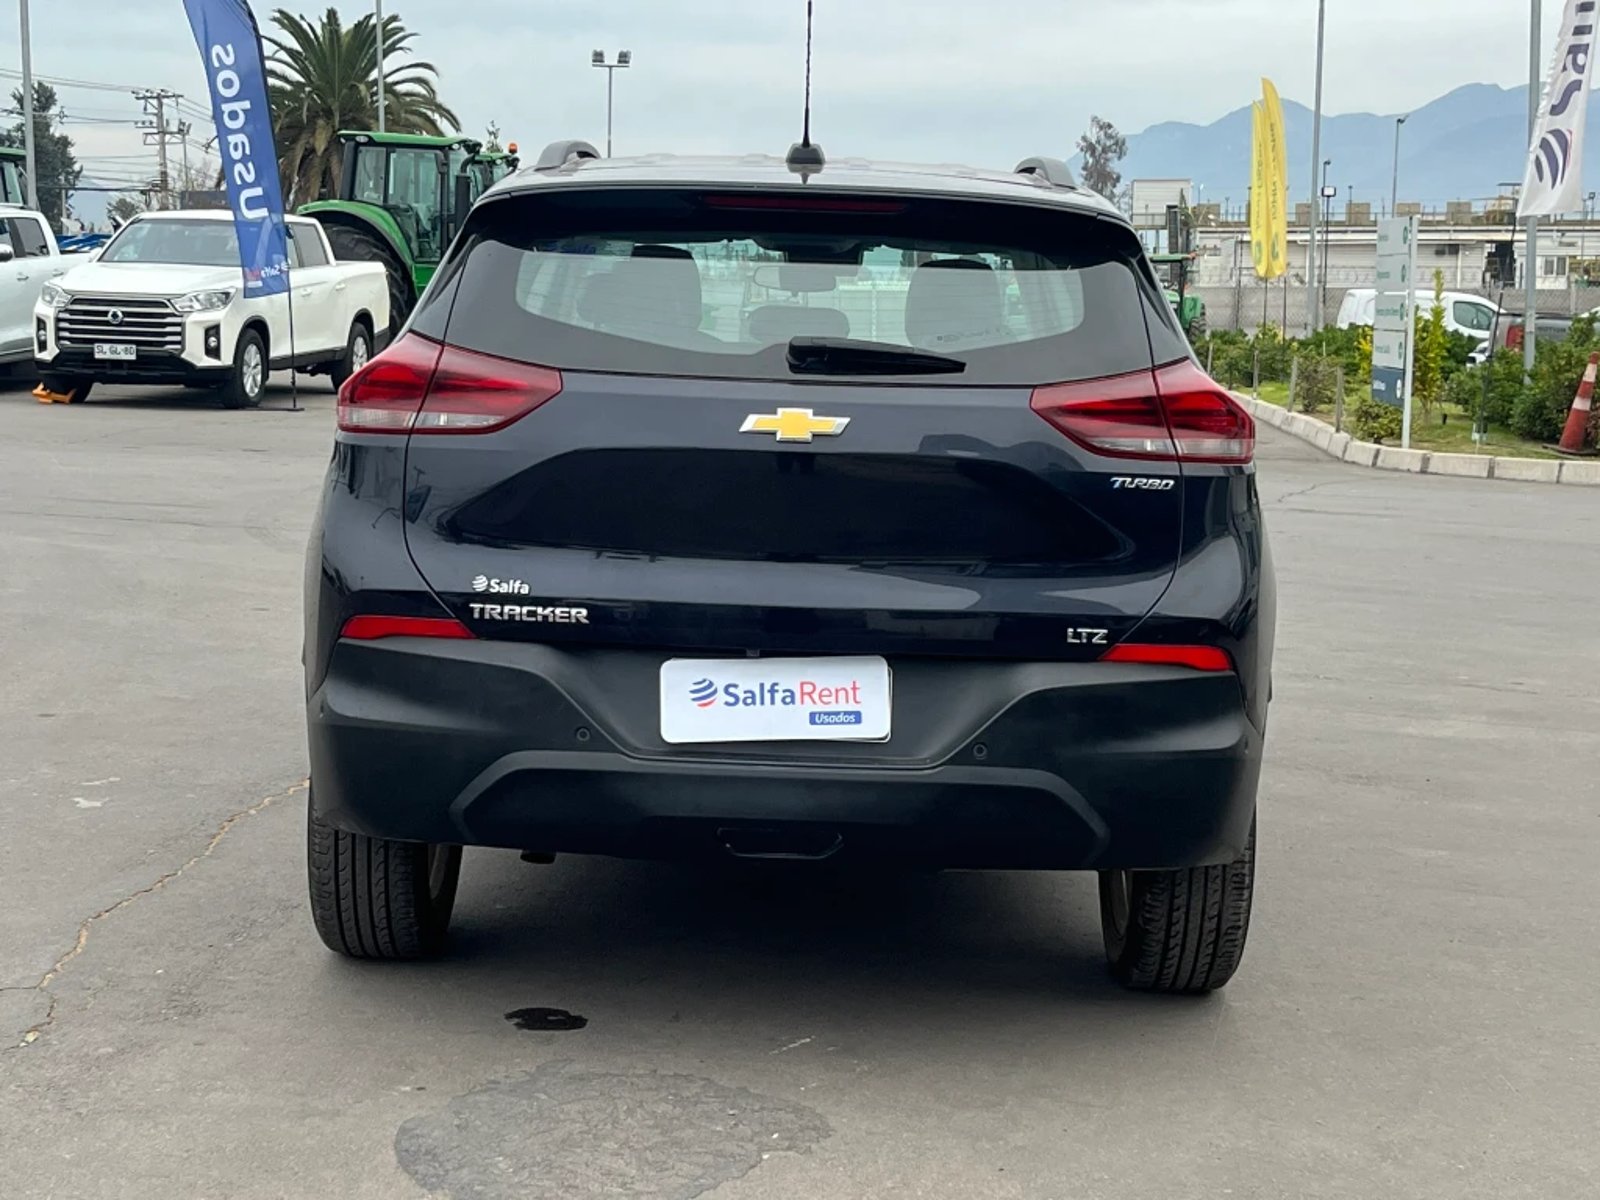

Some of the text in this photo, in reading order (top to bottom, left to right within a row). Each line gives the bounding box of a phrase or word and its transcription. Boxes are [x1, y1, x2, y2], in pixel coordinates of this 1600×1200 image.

[1110, 477, 1175, 490] TURBO
[489, 579, 530, 595] Salfa
[469, 603, 590, 624] TRACKER
[1067, 628, 1108, 643] LTZ
[723, 680, 862, 707] SalfaRent
[815, 712, 856, 724] Usados
